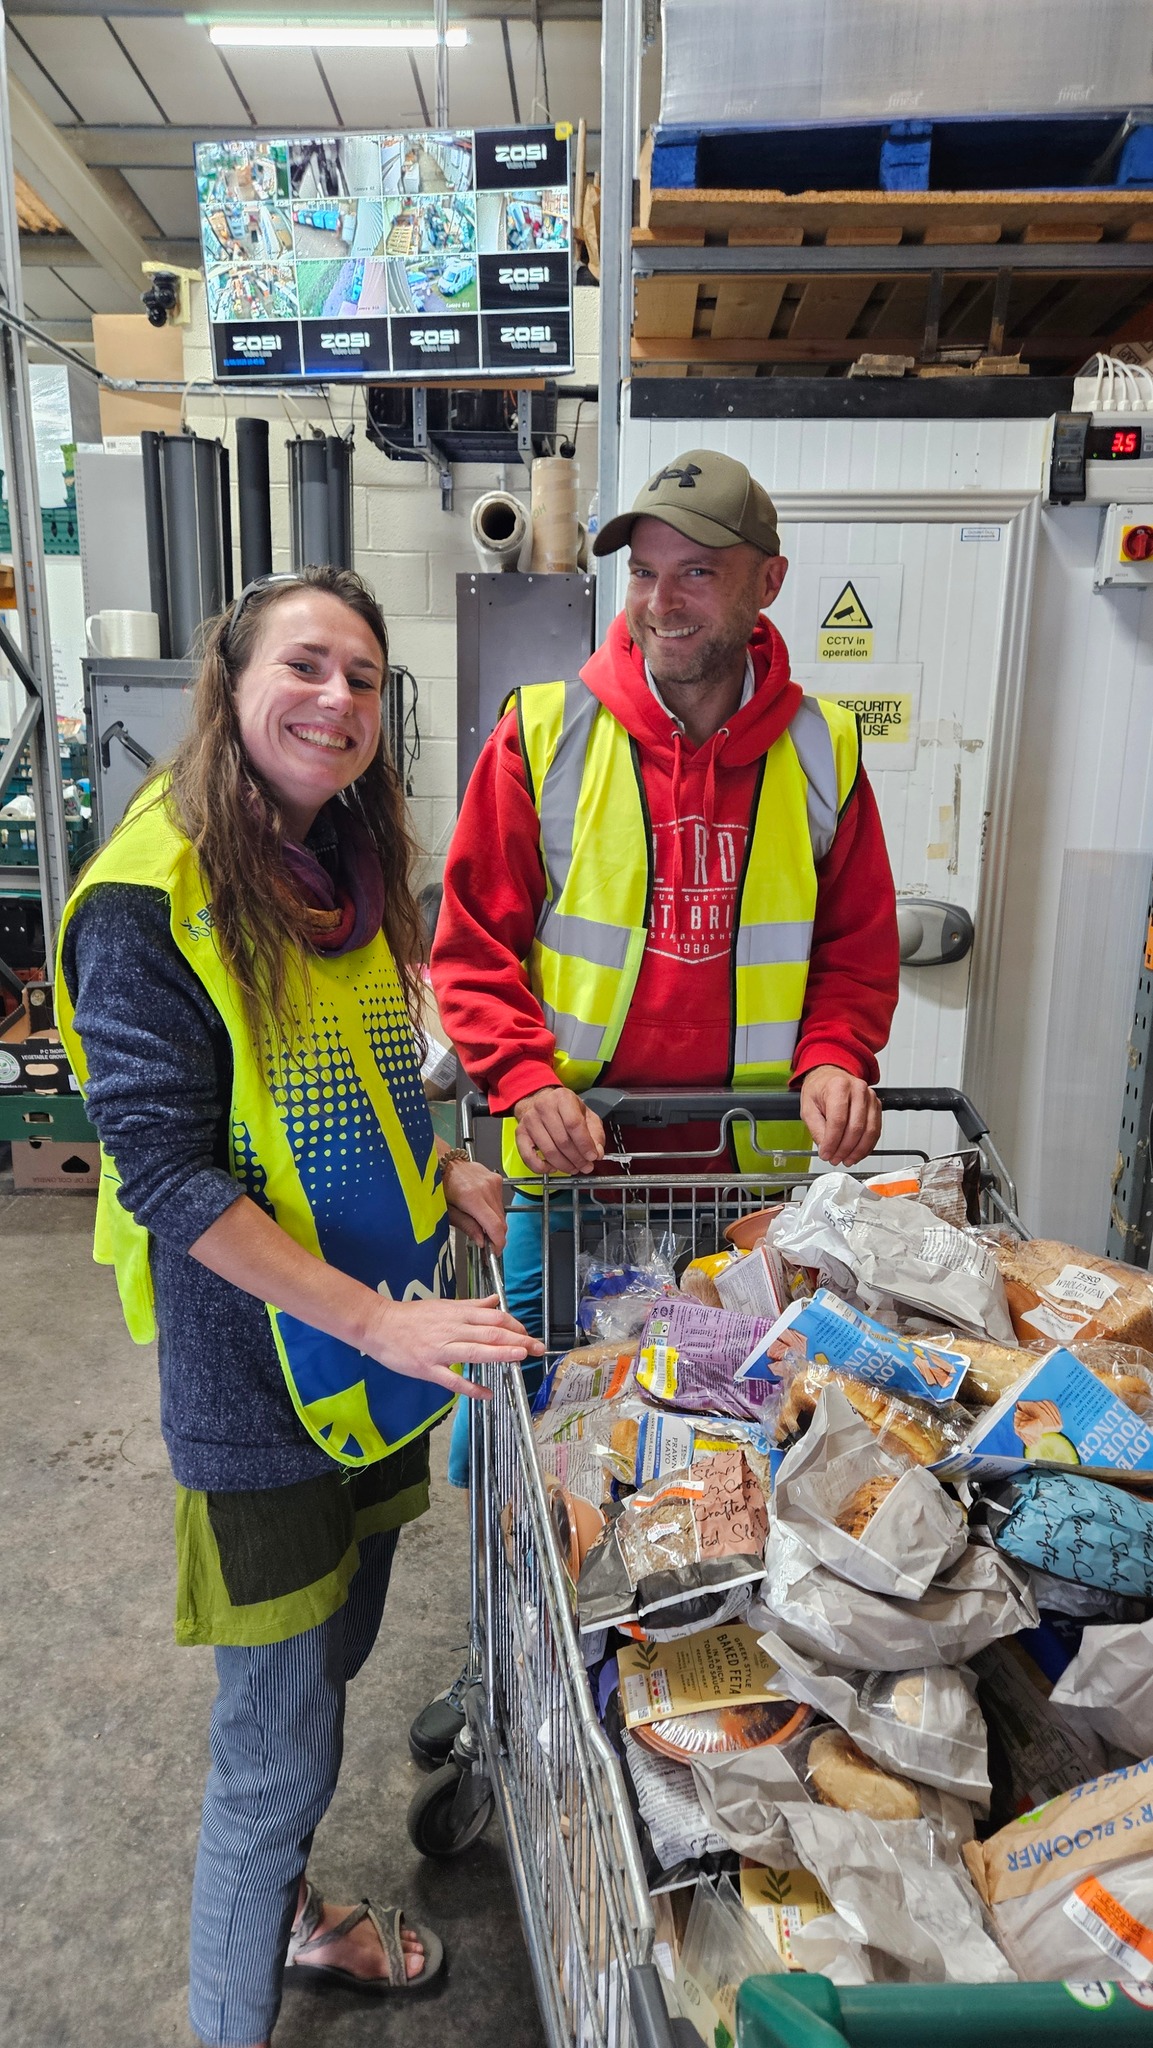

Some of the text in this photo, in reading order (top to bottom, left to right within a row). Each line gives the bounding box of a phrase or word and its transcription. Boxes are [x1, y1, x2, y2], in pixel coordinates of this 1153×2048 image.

[495, 143, 547, 162] ZOSI
[499, 267, 549, 284] ZOSI
[232, 335, 281, 350] ZOSI
[321, 332, 370, 348] ZOSI
[410, 329, 460, 345] ZOSI
[501, 326, 550, 342] ZOSI
[827, 637, 865, 645] CCTV in
[822, 649, 868, 658] operation
[838, 701, 901, 711] SECURITY
[863, 725, 888, 735] USE
[691, 905, 730, 930] BRI
[677, 944, 710, 953] 1988
[1077, 1271, 1101, 1283] TESCO
[1056, 1280, 1104, 1299] WHOLEMEAL
[1063, 1290, 1084, 1299] BREAD
[843, 1334, 878, 1372] LUN
[858, 1345, 891, 1378] YOU
[873, 1354, 904, 1386] LOV
[1079, 1399, 1124, 1463] LUNCH
[1099, 1413, 1145, 1462] YOUR
[698, 1530, 720, 1549] ted
[699, 1667, 704, 1675] TO
[703, 1639, 720, 1695] TOMATO SAUCE
[711, 1648, 719, 1656] IN
[715, 1665, 724, 1683] RICH
[715, 1633, 741, 1694] BAKED FETA
[733, 1637, 751, 1688] GREEK STYLE
[1005, 1819, 1117, 1873] BLOOMER
[1094, 1888, 1146, 1936] CLEARANCE
